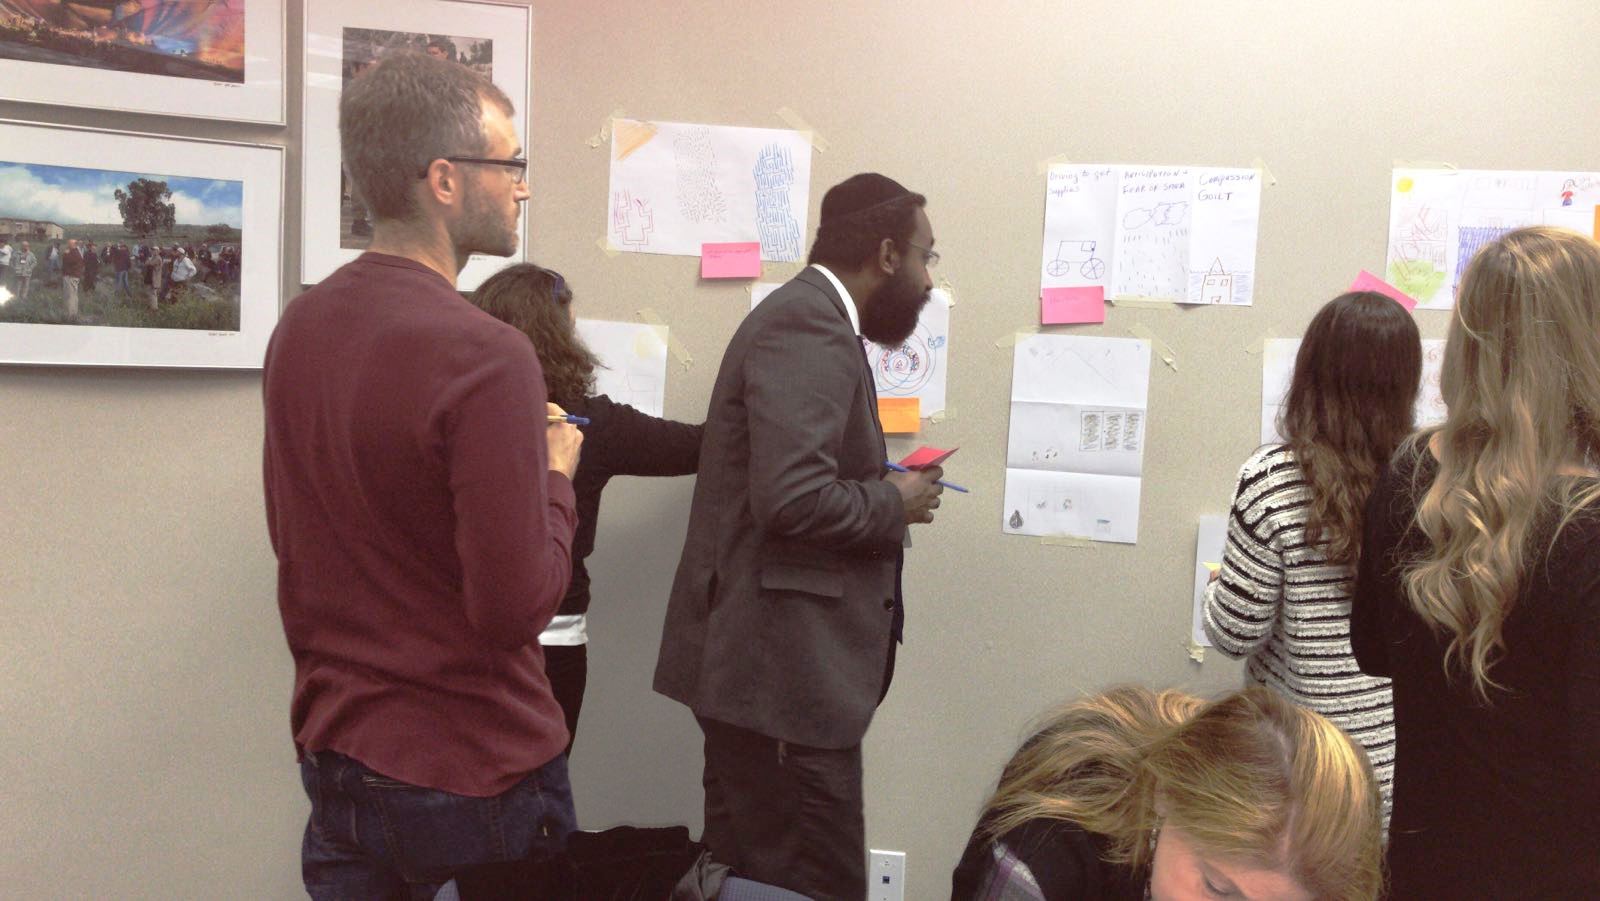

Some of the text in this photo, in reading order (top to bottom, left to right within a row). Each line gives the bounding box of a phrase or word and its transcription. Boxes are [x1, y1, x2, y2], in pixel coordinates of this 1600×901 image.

[1049, 171, 1079, 184] Driving
[1094, 168, 1112, 180] get
[1122, 185, 1146, 195] FEAR
